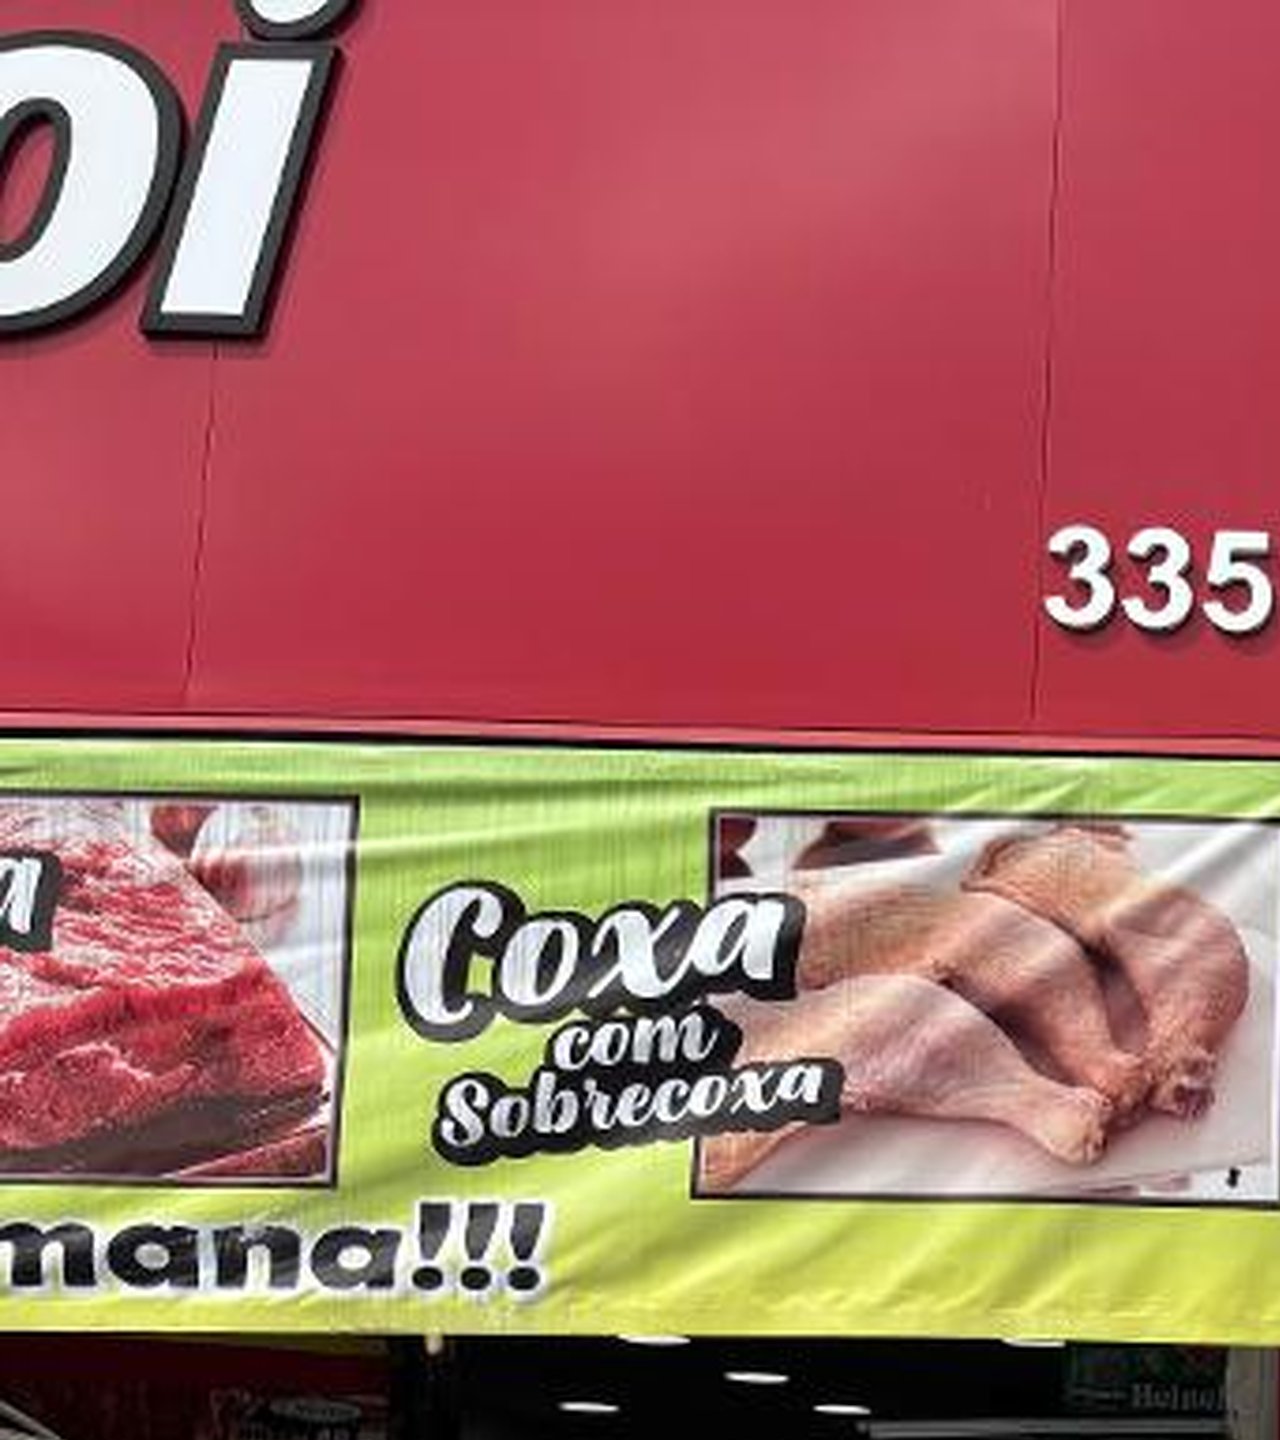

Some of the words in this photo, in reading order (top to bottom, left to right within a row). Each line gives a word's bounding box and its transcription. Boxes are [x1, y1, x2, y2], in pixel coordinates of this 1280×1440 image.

[1043, 524, 1274, 633] 335
[401, 882, 790, 1029] Coxa
[552, 1007, 720, 1071] com
[438, 1062, 825, 1148] Sobrecoxa
